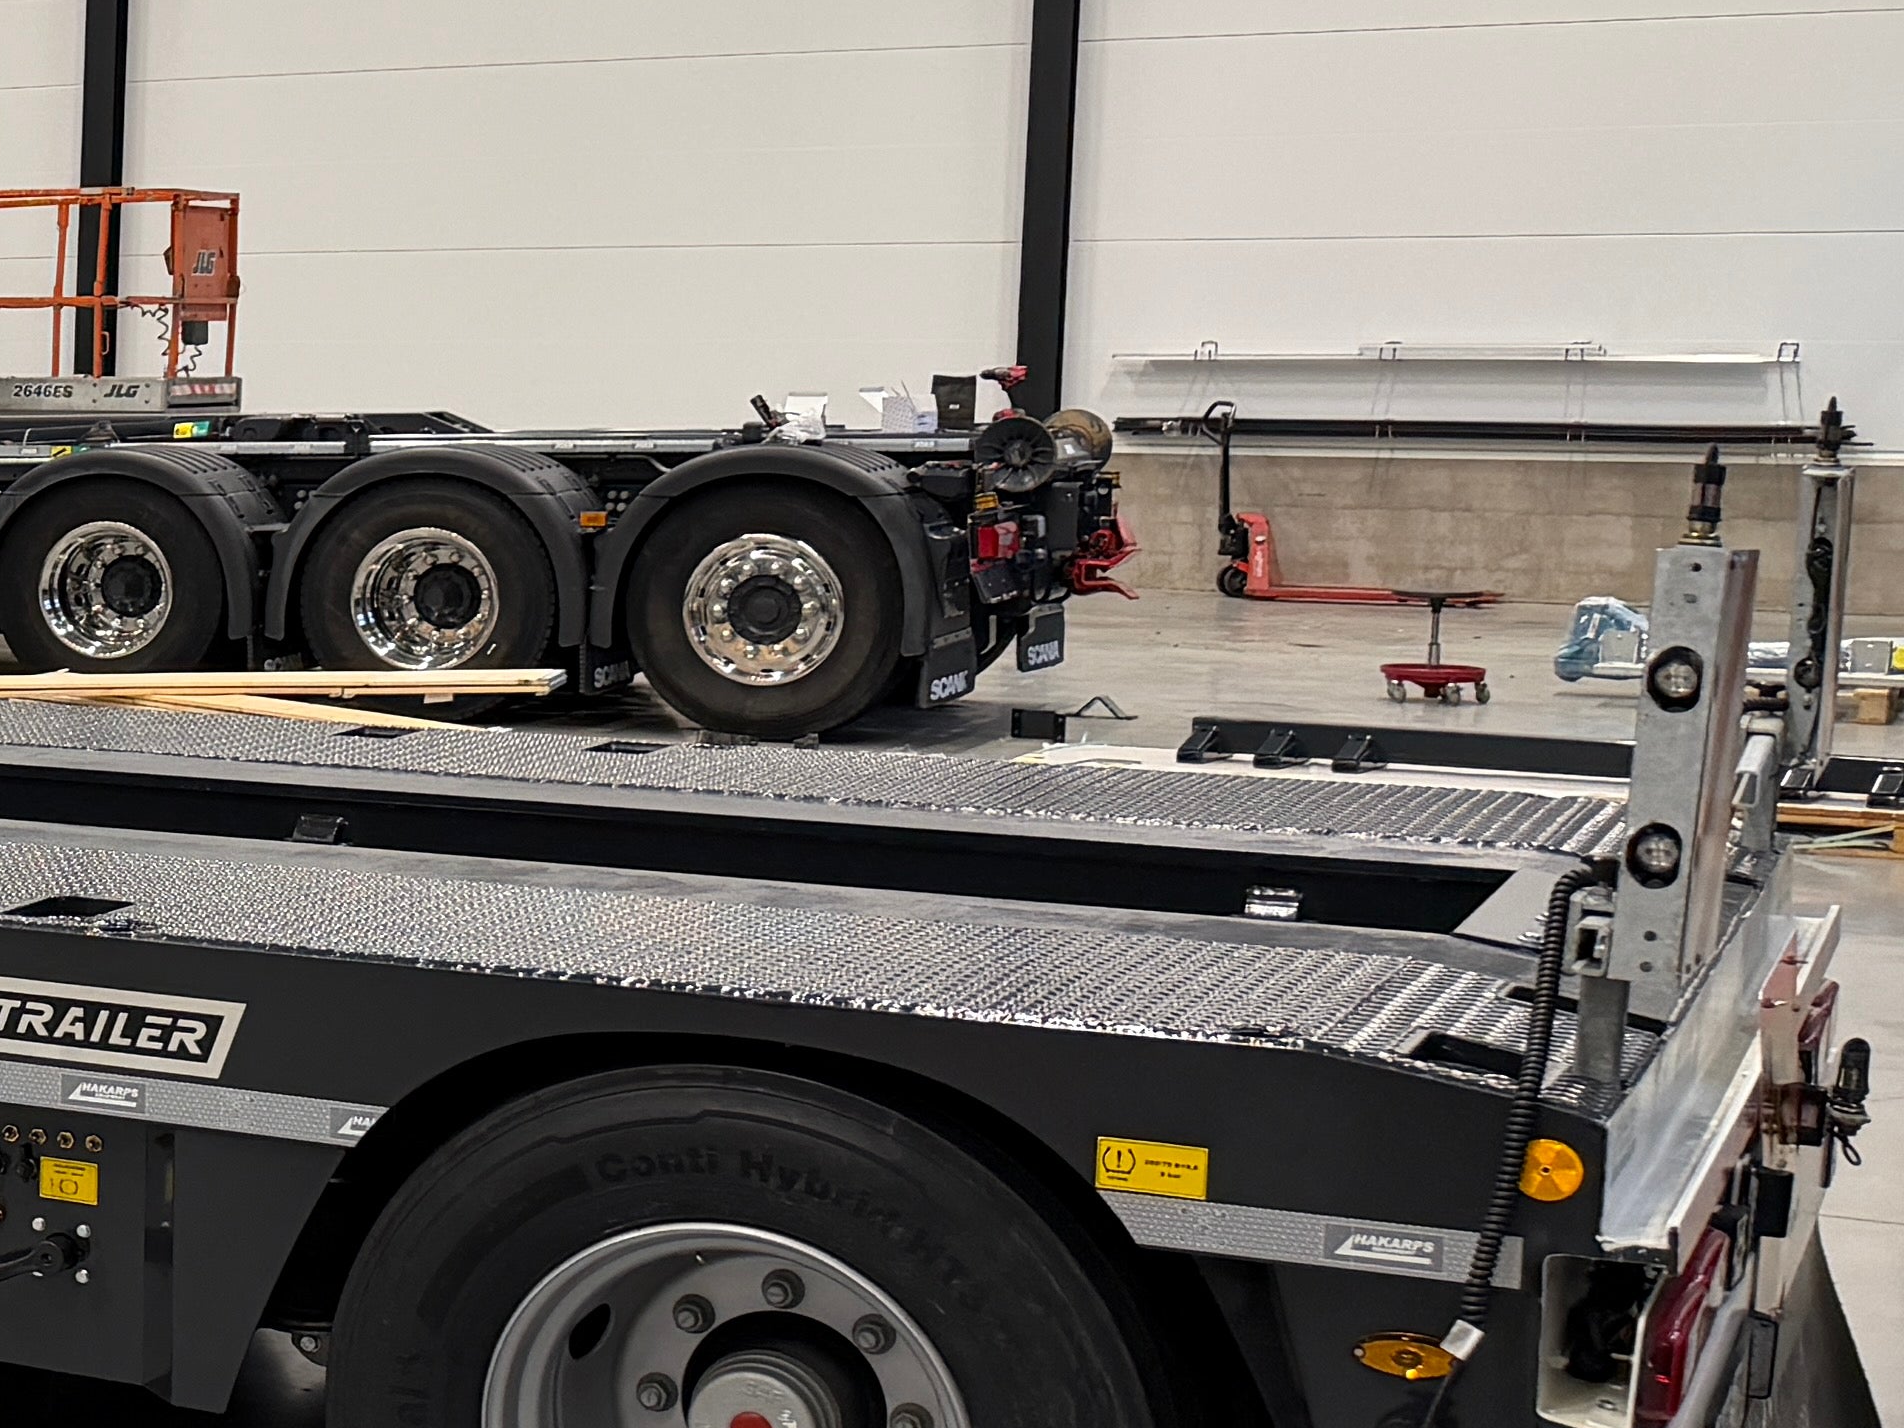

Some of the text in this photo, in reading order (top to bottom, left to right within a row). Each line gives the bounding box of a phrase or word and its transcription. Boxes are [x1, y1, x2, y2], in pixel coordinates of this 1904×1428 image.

[192, 251, 216, 275] JLG
[13, 384, 141, 398] 2646ES JLG
[1027, 640, 1060, 666] SCANIA
[83, 1082, 139, 1098] HAKARPS
[599, 1141, 720, 1185] Conti
[1353, 1233, 1436, 1253] HAKARPS
